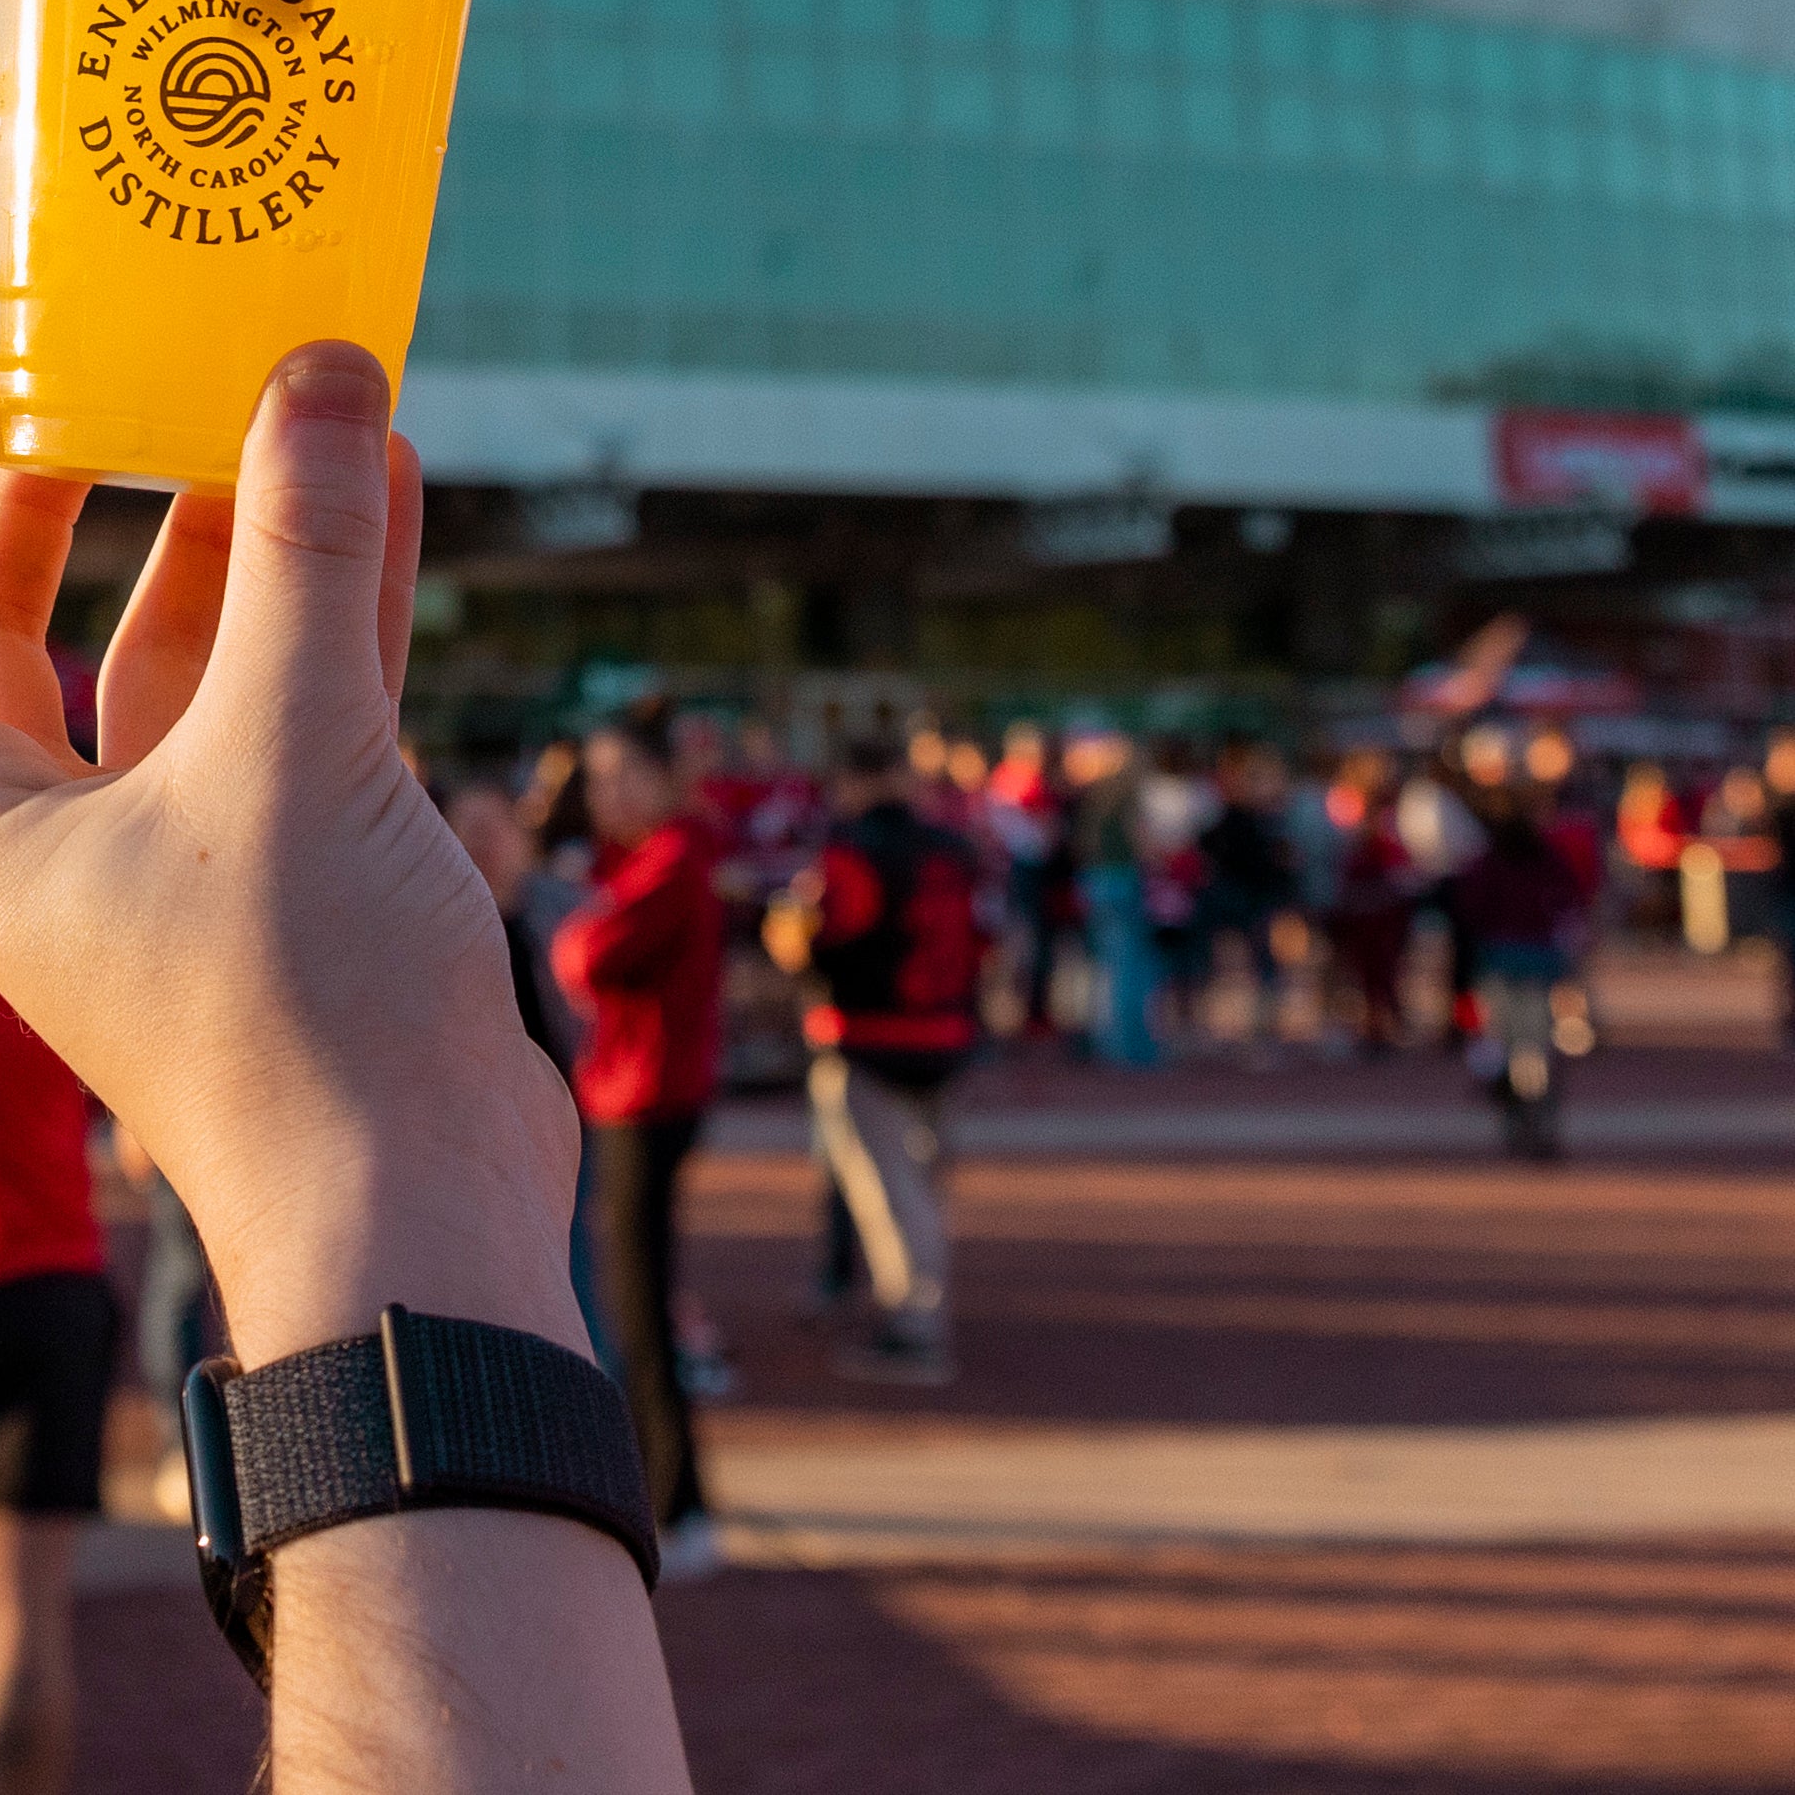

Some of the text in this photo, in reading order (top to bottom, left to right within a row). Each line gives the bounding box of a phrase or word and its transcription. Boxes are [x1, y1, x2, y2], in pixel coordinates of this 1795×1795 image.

[78, 115, 341, 245] DISTILLERY
[124, 84, 308, 189] NORTH CAROLINA
